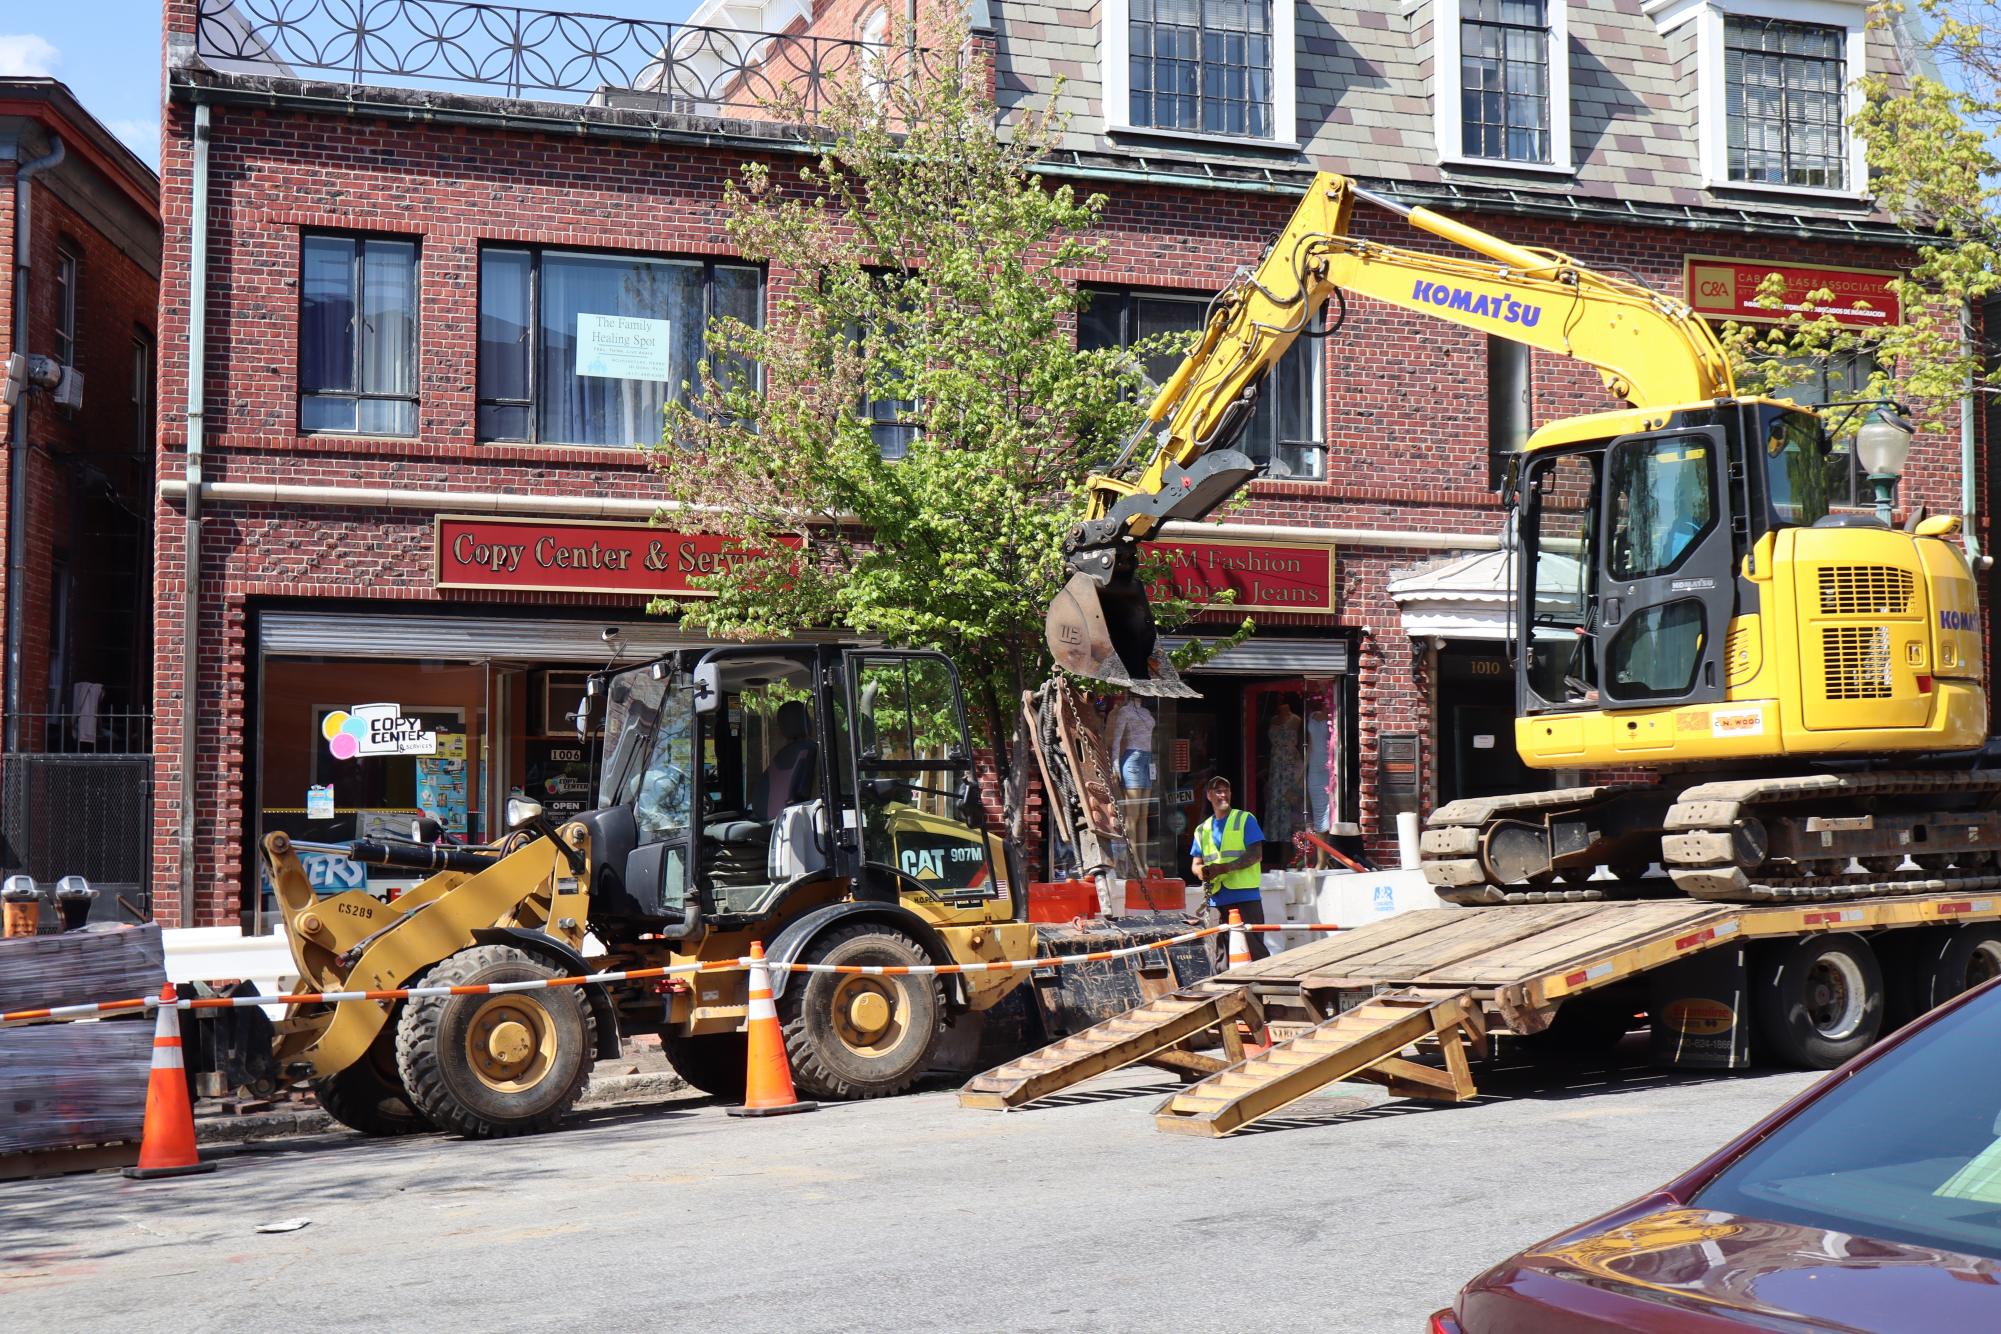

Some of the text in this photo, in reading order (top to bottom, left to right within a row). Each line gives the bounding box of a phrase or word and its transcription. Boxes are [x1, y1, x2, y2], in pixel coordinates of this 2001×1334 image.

[1701, 280, 1729, 297] C&A
[1812, 279, 1818, 288] &
[1412, 280, 1541, 327] KOMATSU
[596, 316, 652, 332] The Family
[592, 331, 655, 350] Healing Spot
[453, 533, 525, 572] Copy
[535, 536, 632, 571] Center
[644, 540, 670, 570] &
[1208, 551, 1301, 573] Fashion
[1672, 579, 1713, 589] KOMATSU
[1252, 581, 1320, 604] Jeans
[1471, 661, 1500, 674] 1010
[371, 717, 420, 732] COPY
[1735, 718, 1760, 726] WOOD
[371, 730, 428, 744] CENTER
[553, 750, 580, 760] 1006
[1168, 790, 1191, 801] OPEN
[552, 802, 580, 810] OPEN
[901, 847, 983, 879] CAT 907M
[338, 902, 373, 919] CS289
